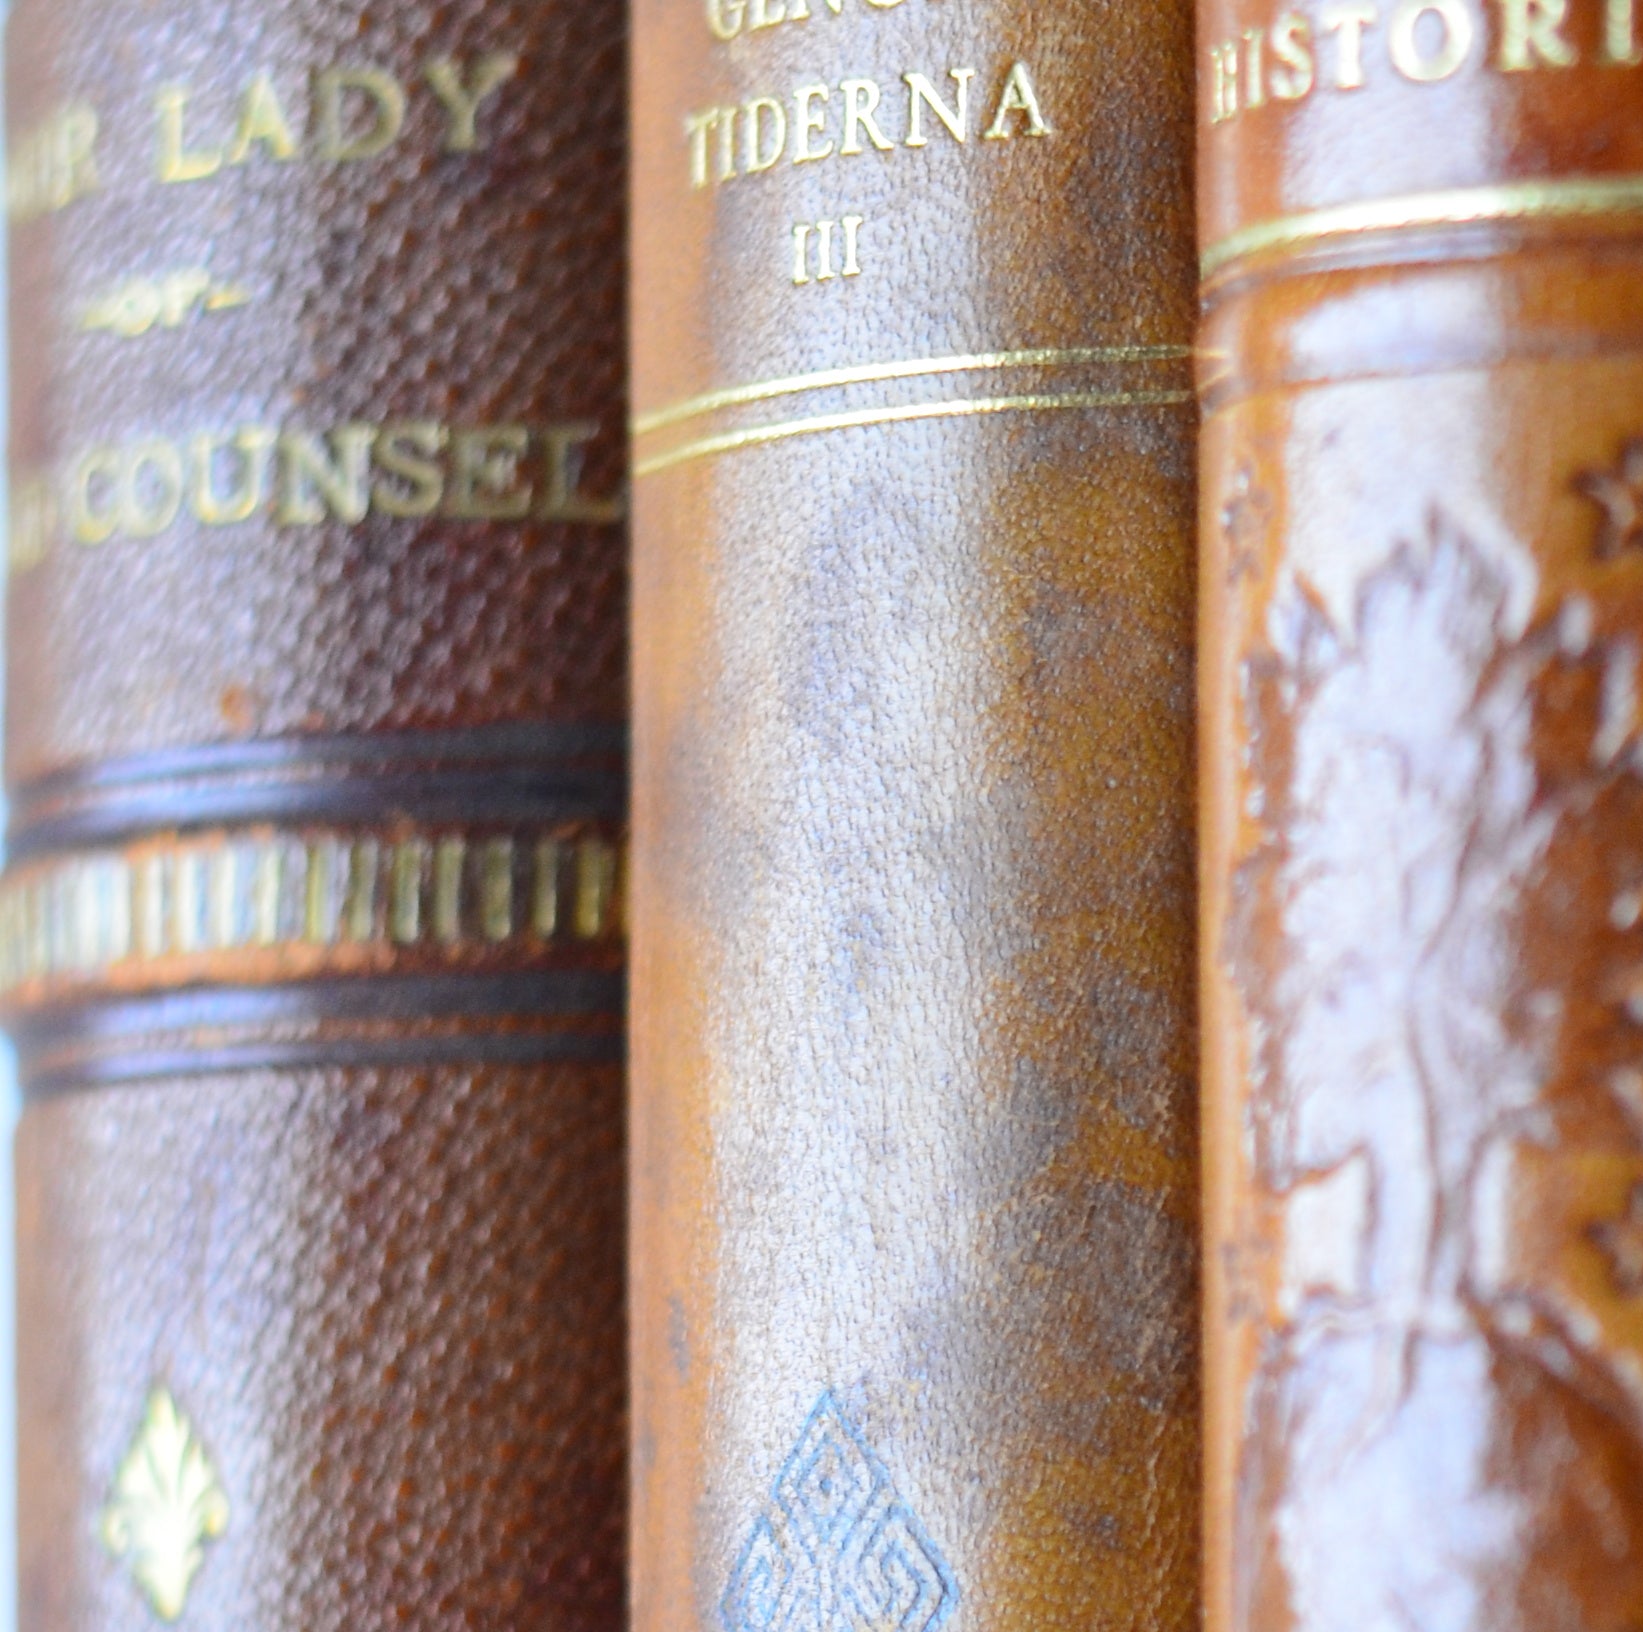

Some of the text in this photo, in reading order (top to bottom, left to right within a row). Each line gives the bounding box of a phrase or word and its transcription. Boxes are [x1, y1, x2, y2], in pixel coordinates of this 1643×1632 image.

[152, 54, 516, 184] LADY
[684, 60, 1052, 190] TIDERNA
[791, 215, 863, 284] III
[74, 424, 618, 546] COUNSEL
